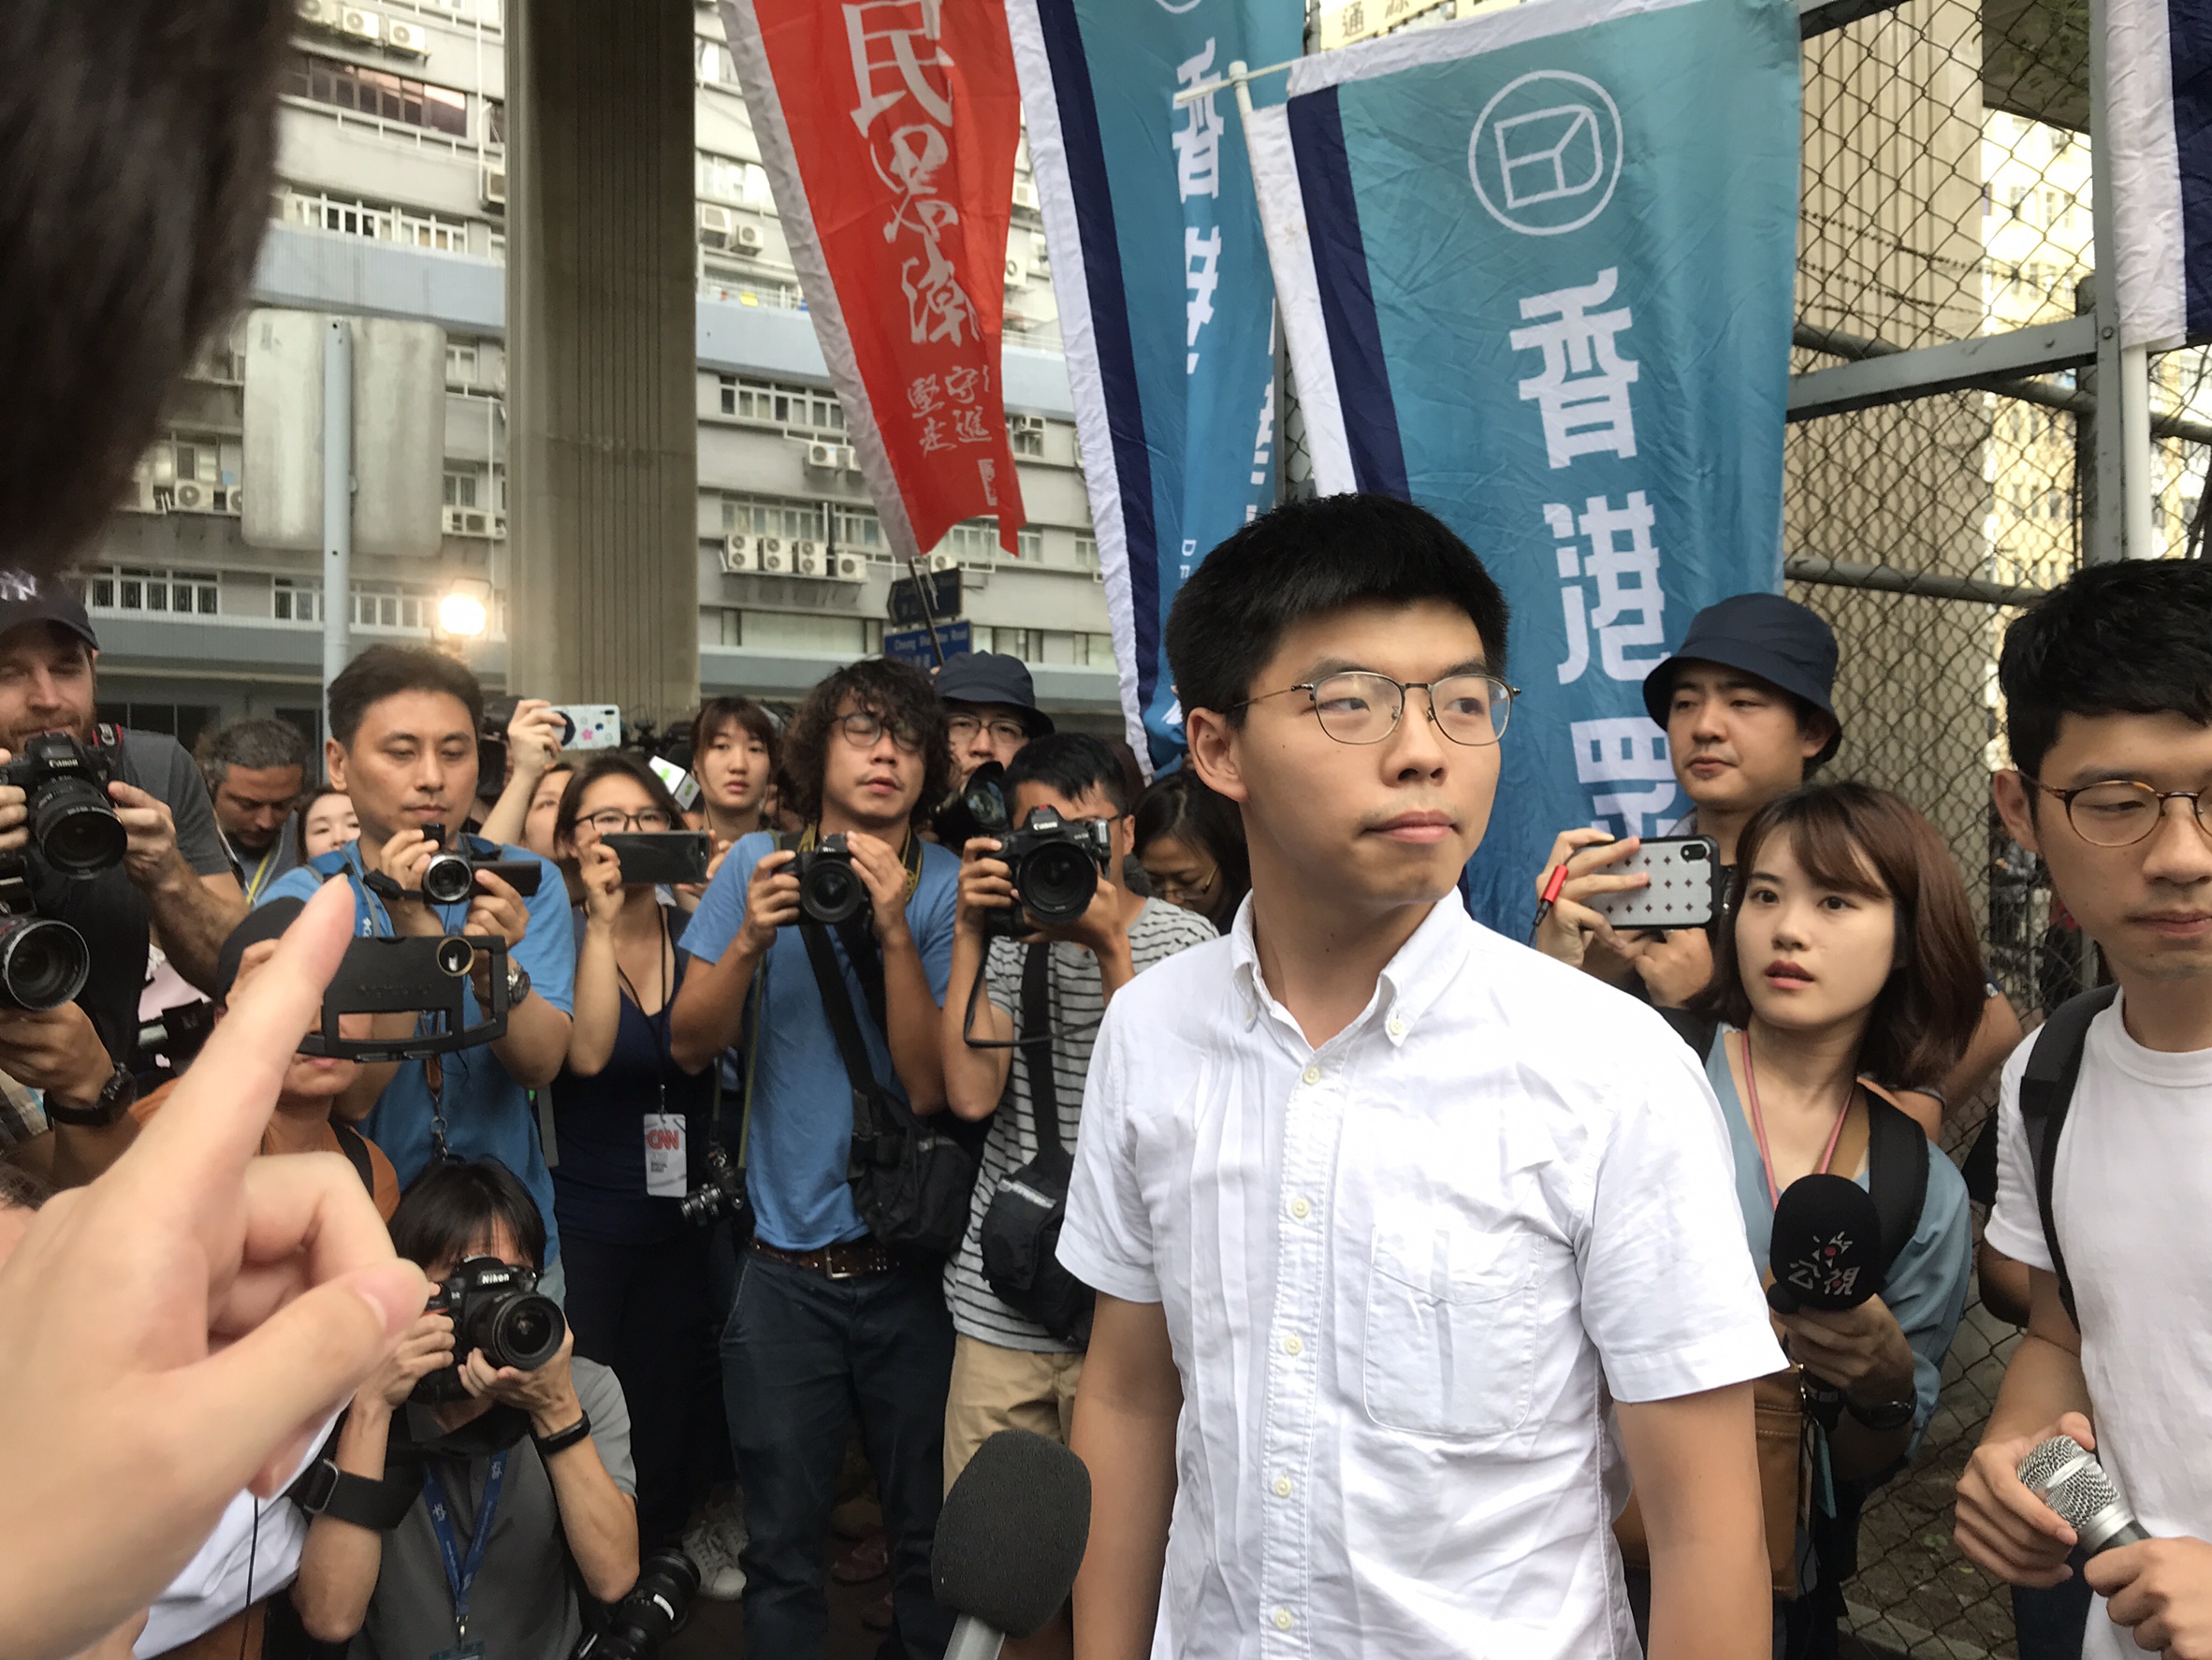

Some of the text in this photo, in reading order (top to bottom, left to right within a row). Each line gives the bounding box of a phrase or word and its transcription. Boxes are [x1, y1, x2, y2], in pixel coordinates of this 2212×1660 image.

[907, 364, 990, 418] 堅守
[49, 759, 79, 768] Canon
[1032, 822, 1058, 831] Canon
[647, 1129, 679, 1151] CNN
[481, 1273, 510, 1285] Nikon
[1788, 1260, 1861, 1296] 公視
